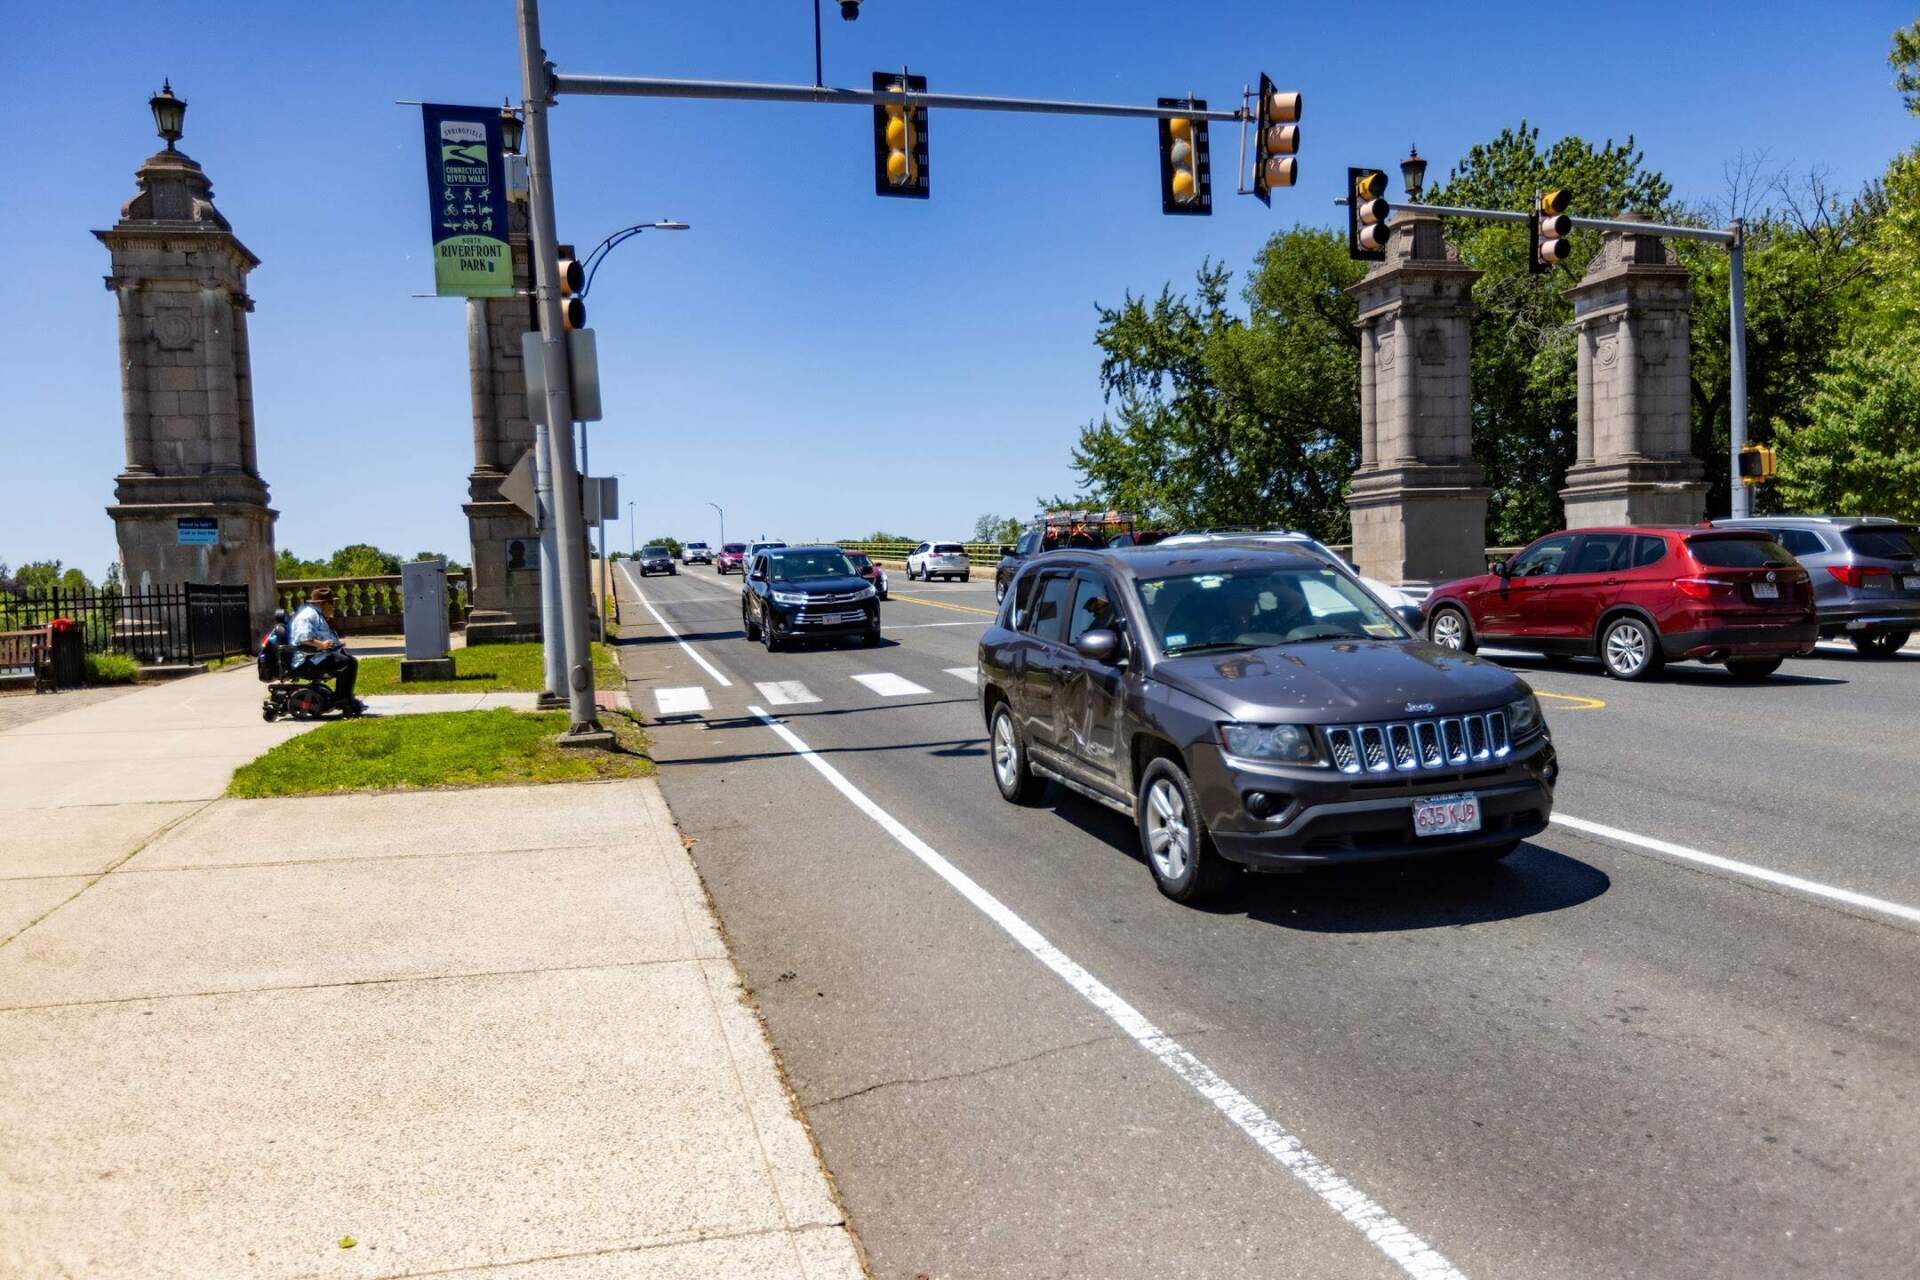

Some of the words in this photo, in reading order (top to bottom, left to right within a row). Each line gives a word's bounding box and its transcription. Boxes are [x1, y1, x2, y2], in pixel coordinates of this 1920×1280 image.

[446, 167, 487, 175] CONNECTICUT
[447, 174, 468, 183] RIVER
[468, 175, 487, 183] WALK
[441, 245, 502, 257] RIVERFRONT
[461, 258, 487, 271] PARK
[1405, 702, 1435, 713] Jeep
